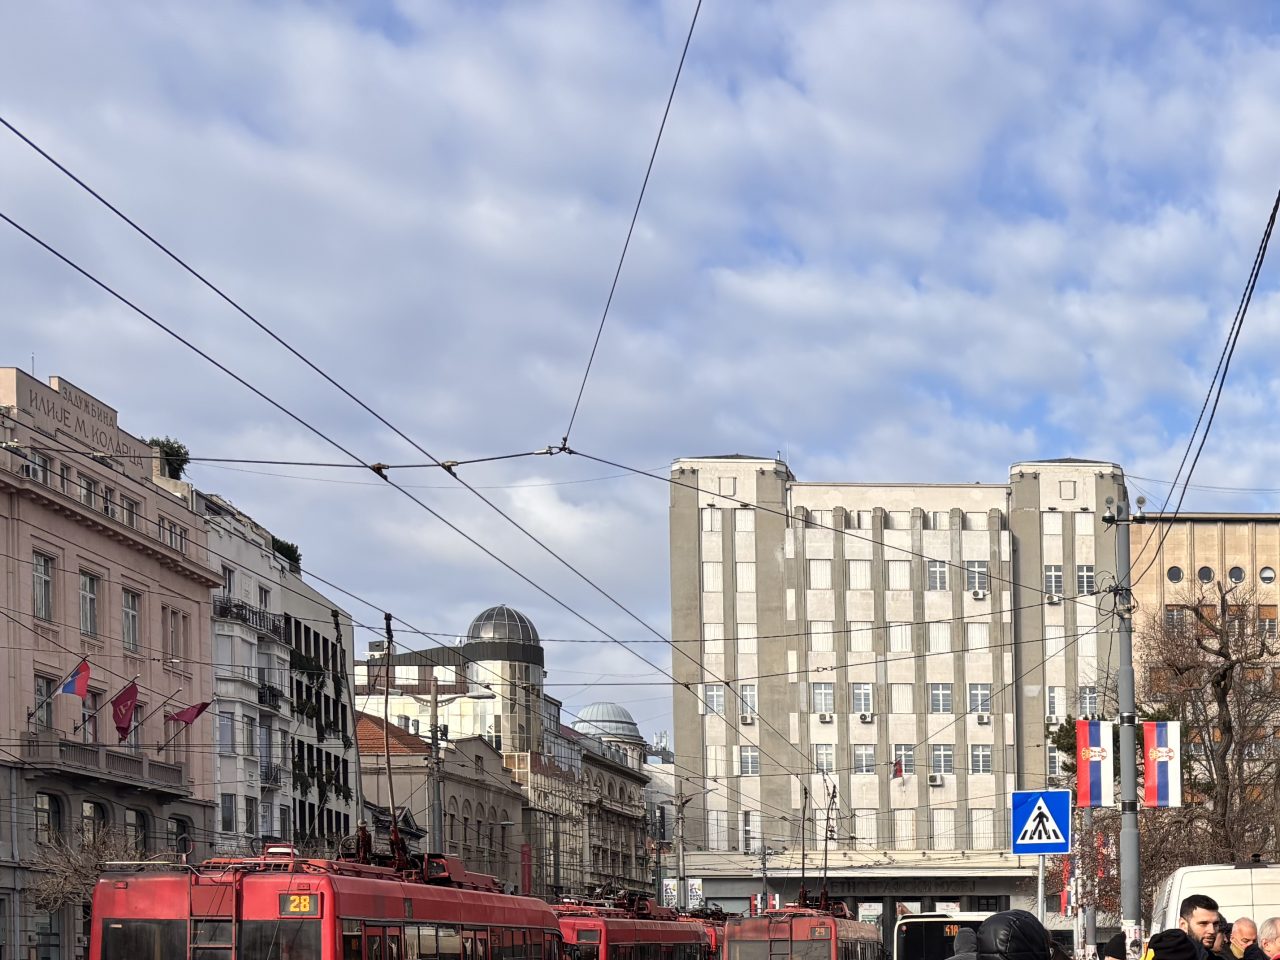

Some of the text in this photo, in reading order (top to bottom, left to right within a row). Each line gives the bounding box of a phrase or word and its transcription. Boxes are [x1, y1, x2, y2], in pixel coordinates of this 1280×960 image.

[29, 388, 72, 429] ИЛИЈЕ
[91, 425, 144, 470] КОЛАРЦА
[62, 387, 115, 430] ЗАДУЖБИНА
[289, 895, 311, 912] 28
